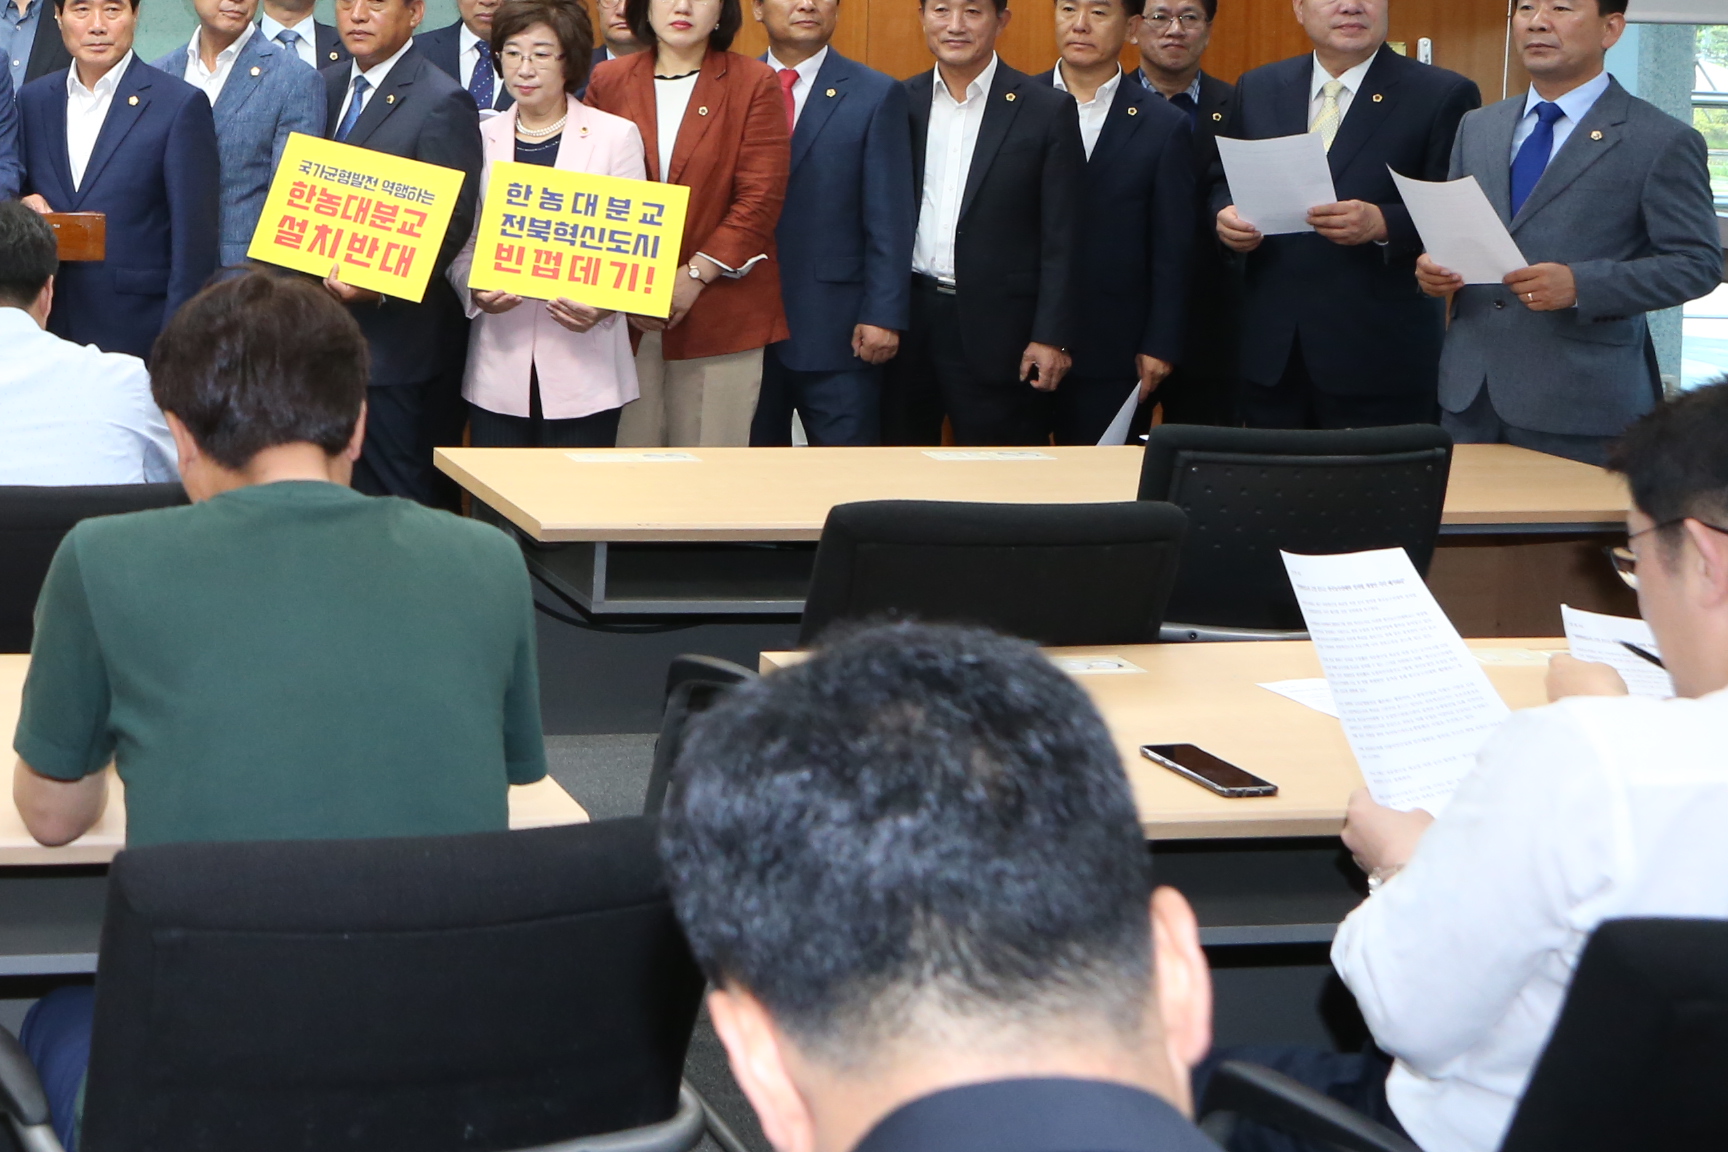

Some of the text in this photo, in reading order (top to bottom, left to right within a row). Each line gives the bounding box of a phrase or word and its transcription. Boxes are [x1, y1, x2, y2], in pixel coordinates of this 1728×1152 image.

[299, 160, 434, 205] 국가균형발전 역행하는
[287, 181, 427, 237] 한농대분교
[501, 214, 660, 258] 전북혁신도시
